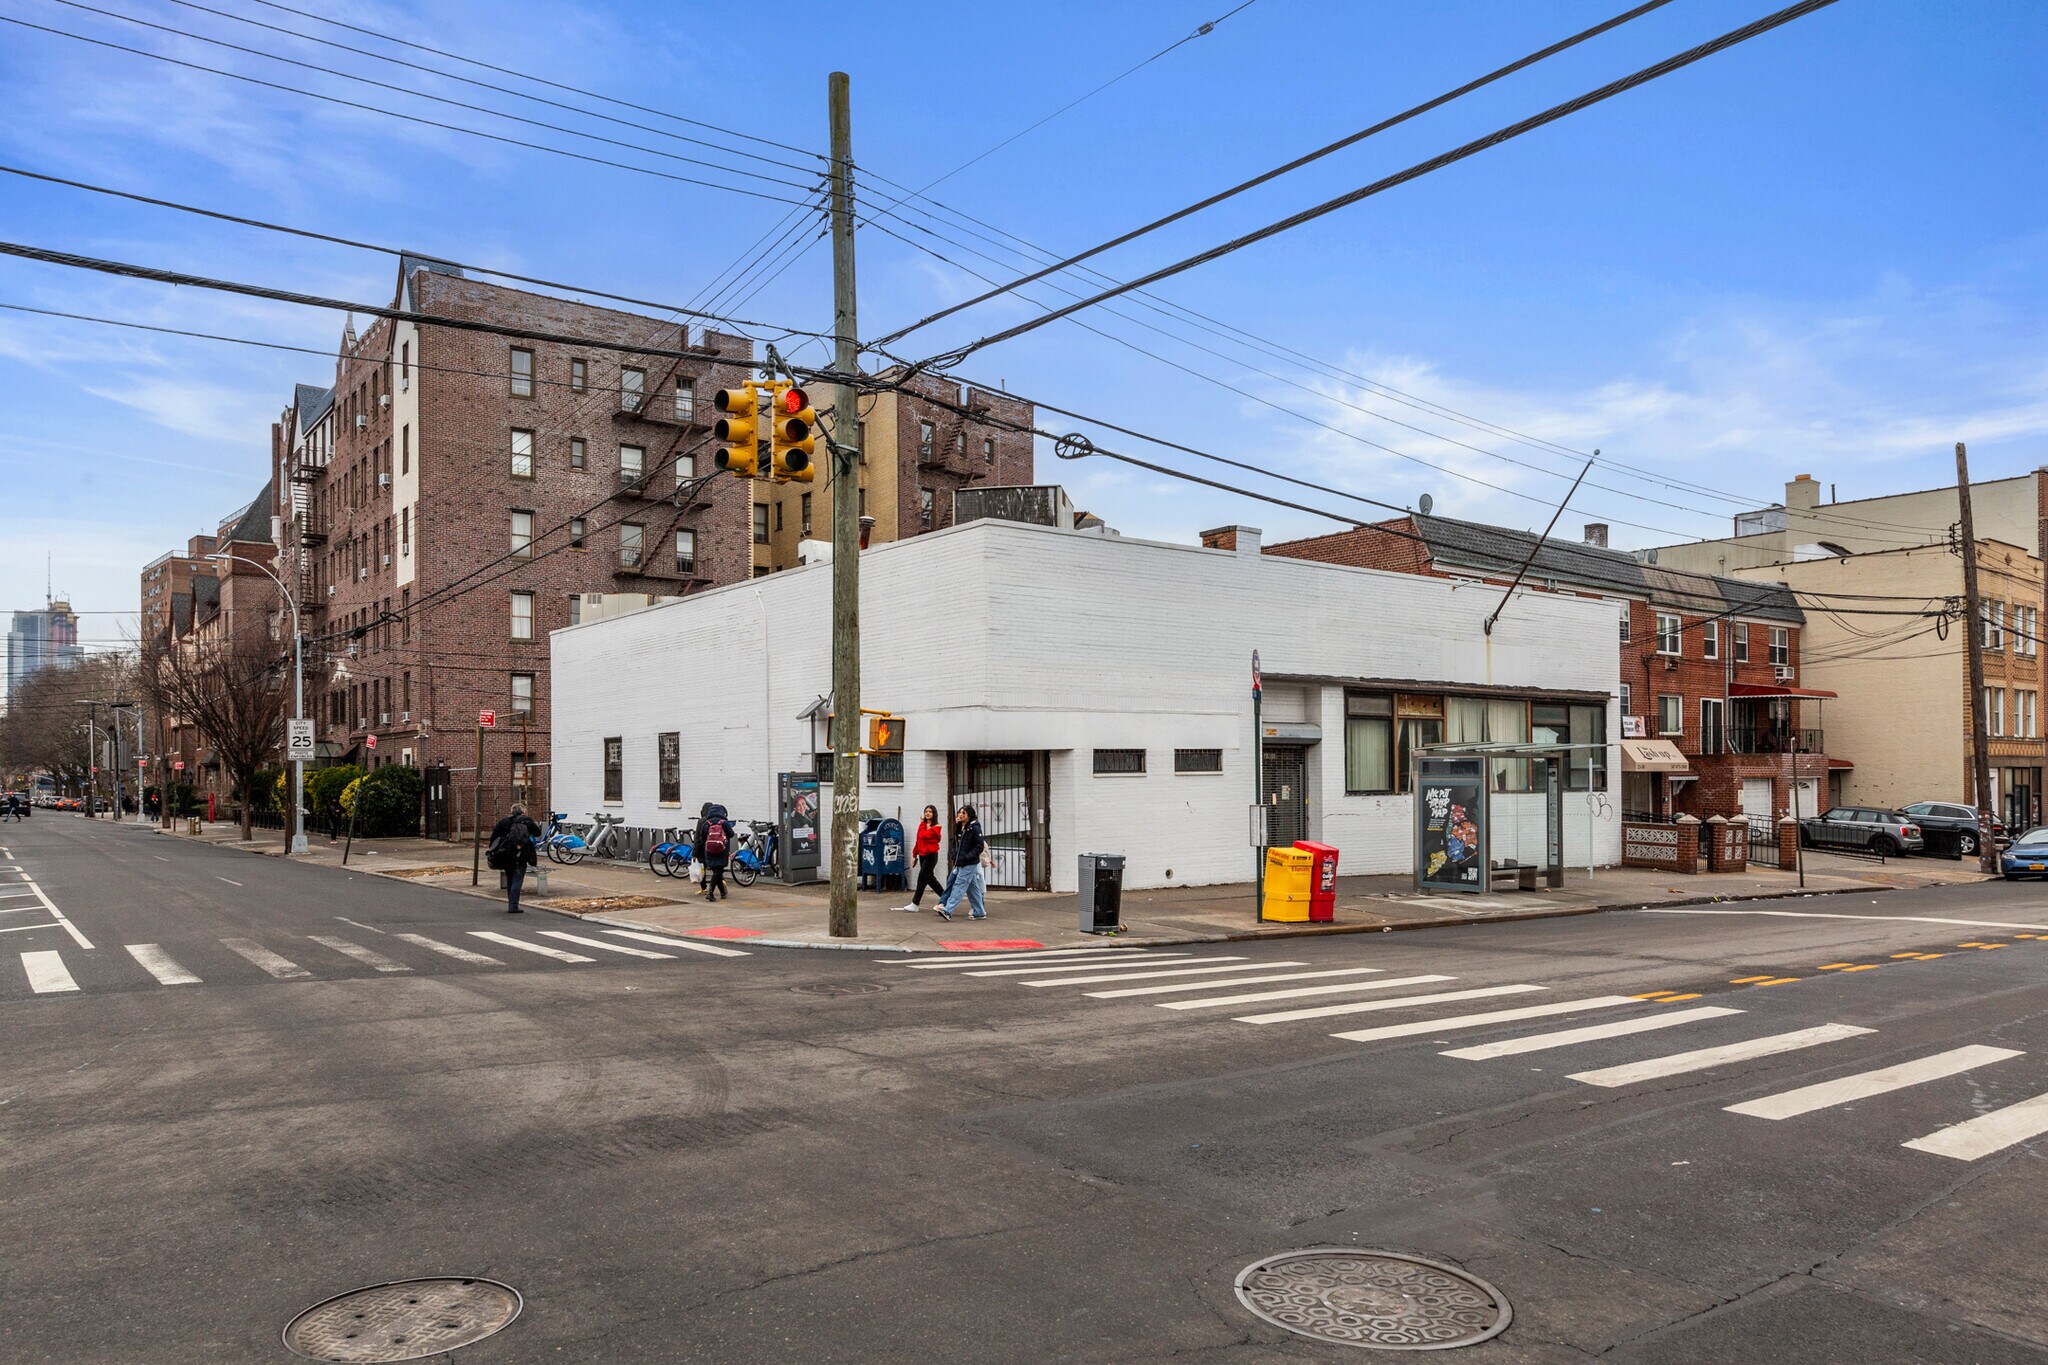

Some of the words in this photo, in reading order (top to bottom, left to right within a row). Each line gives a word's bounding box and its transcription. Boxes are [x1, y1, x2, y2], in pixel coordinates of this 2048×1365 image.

[292, 736, 312, 747] 25
[1425, 788, 1440, 801] NYC
[1439, 788, 1453, 799] PUT
